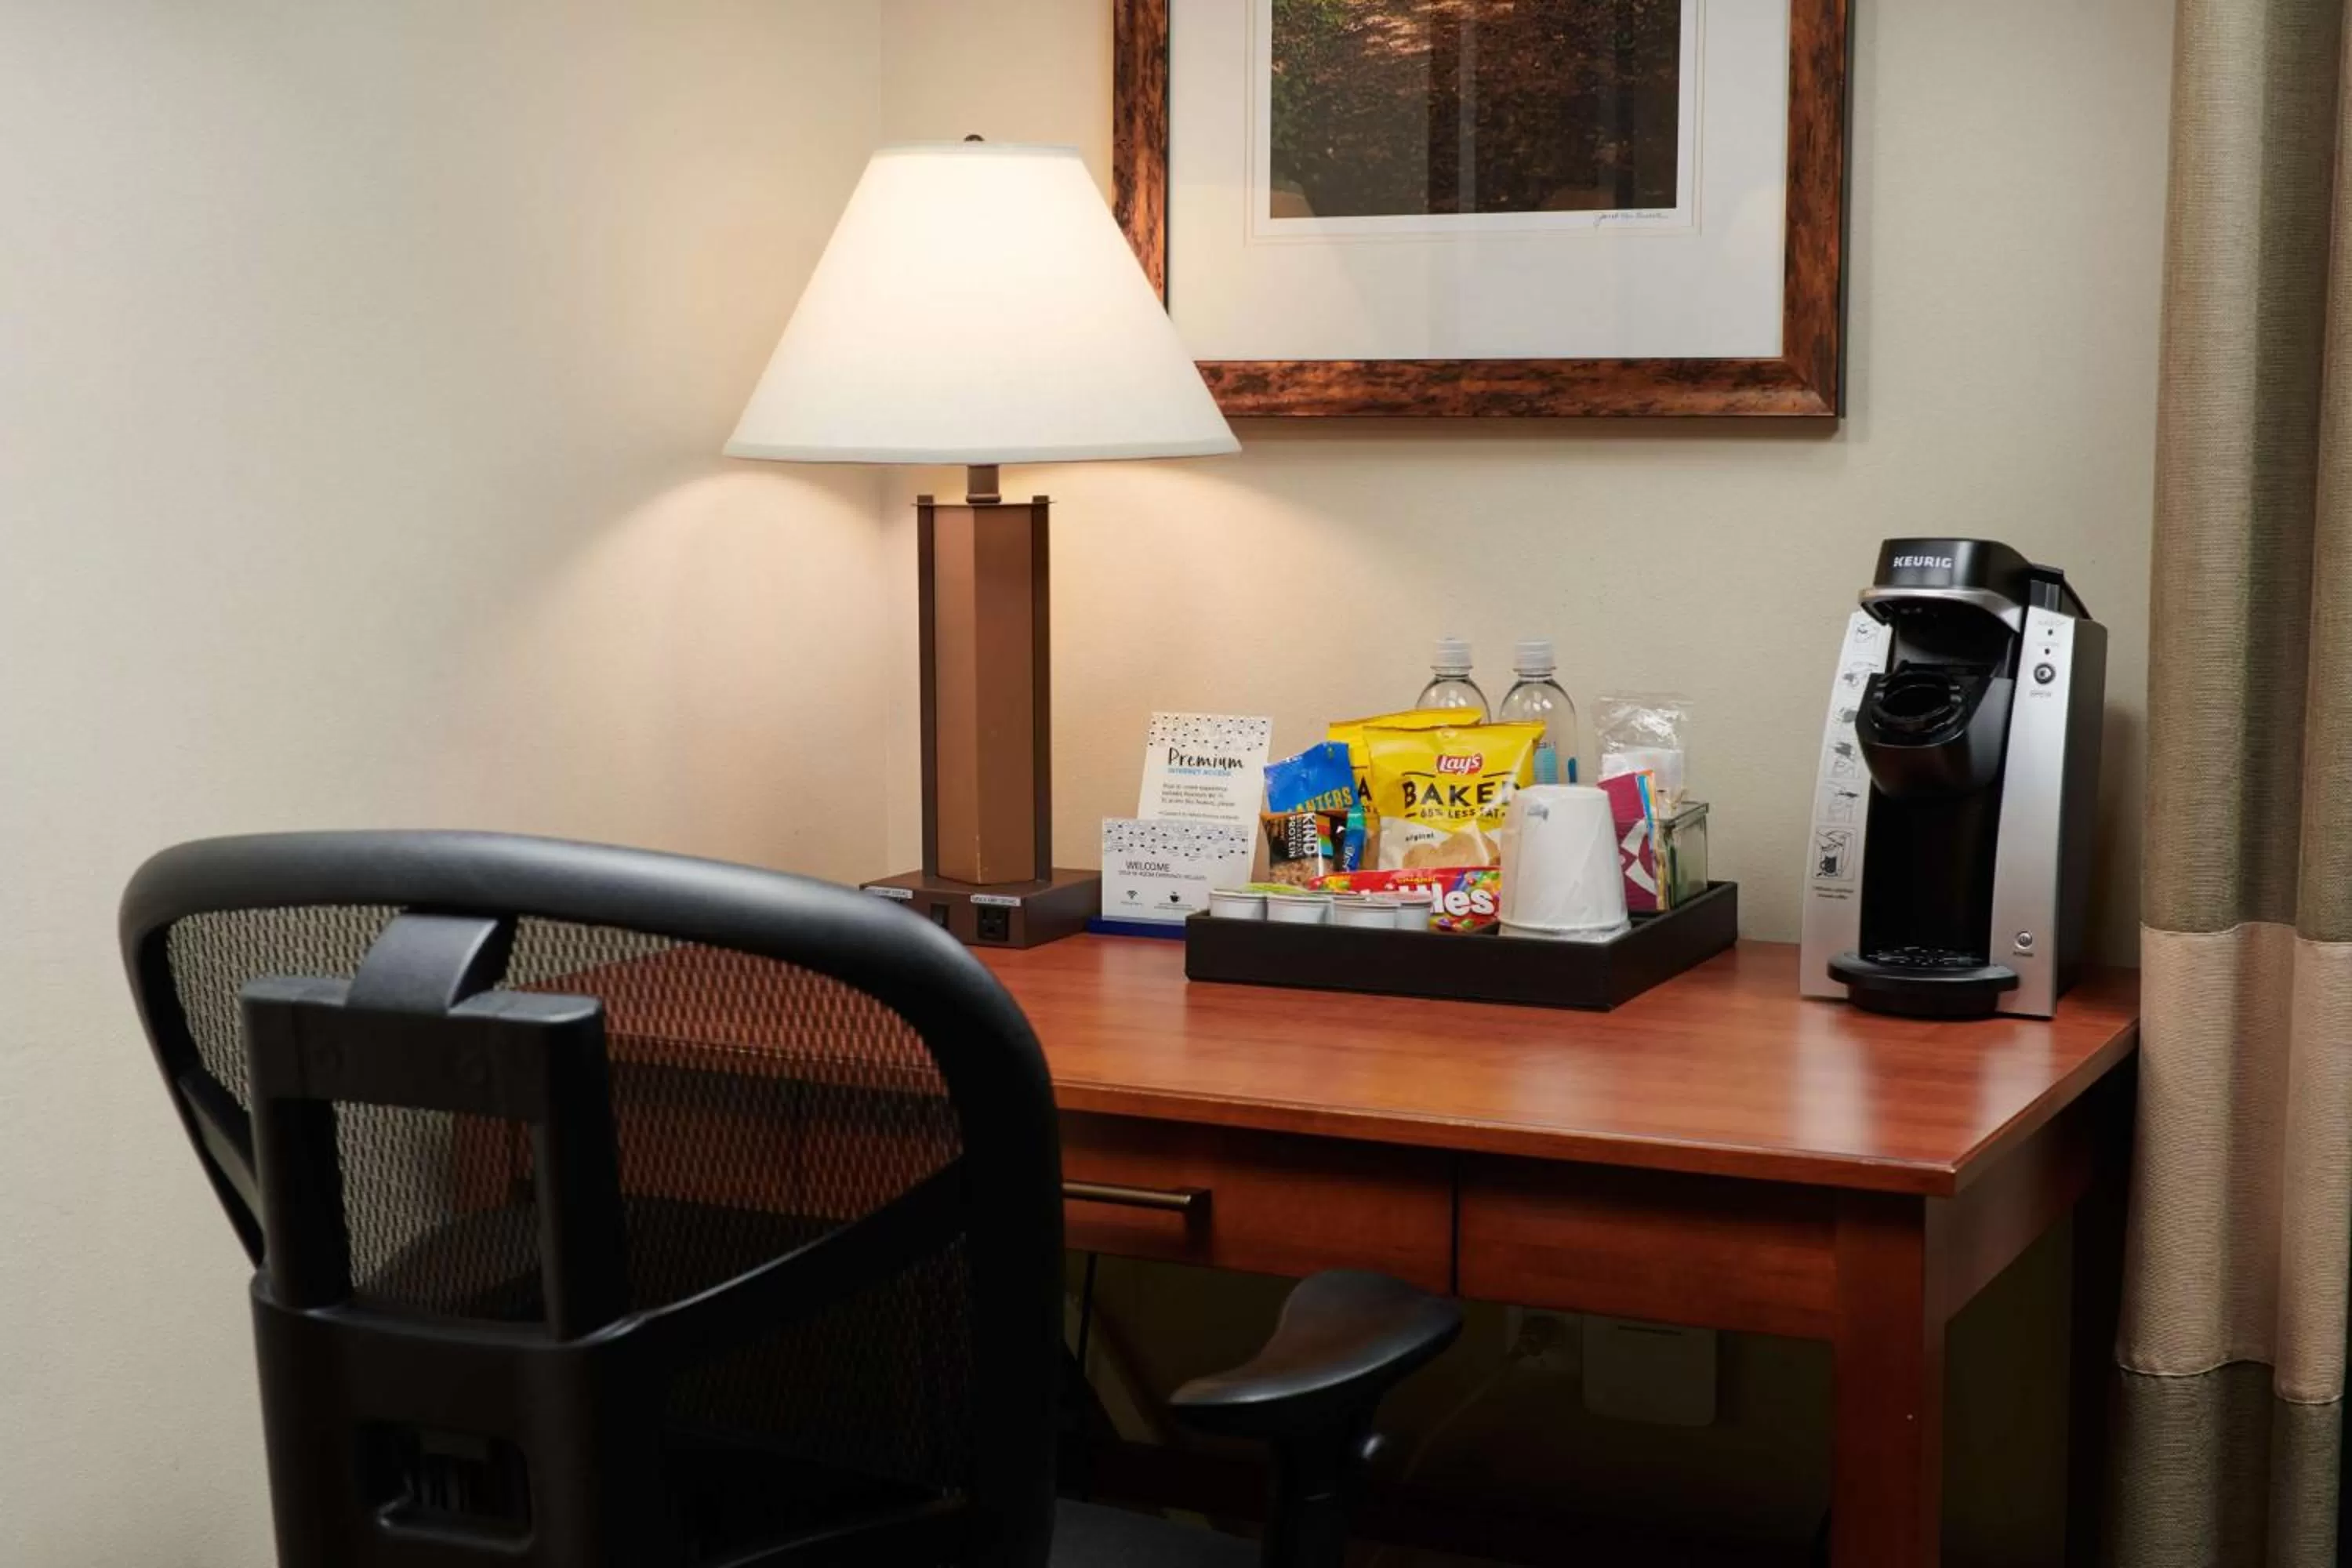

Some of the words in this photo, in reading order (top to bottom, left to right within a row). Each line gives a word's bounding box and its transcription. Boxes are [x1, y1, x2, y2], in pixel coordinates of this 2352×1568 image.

[1893, 555, 1952, 568] KEURIG
[1167, 746, 1244, 771] Premium
[1439, 753, 1481, 775] Lay's
[1448, 808, 1476, 819] LESS
[1303, 811, 1318, 855] KIND
[1126, 860, 1171, 873] WELCOME
